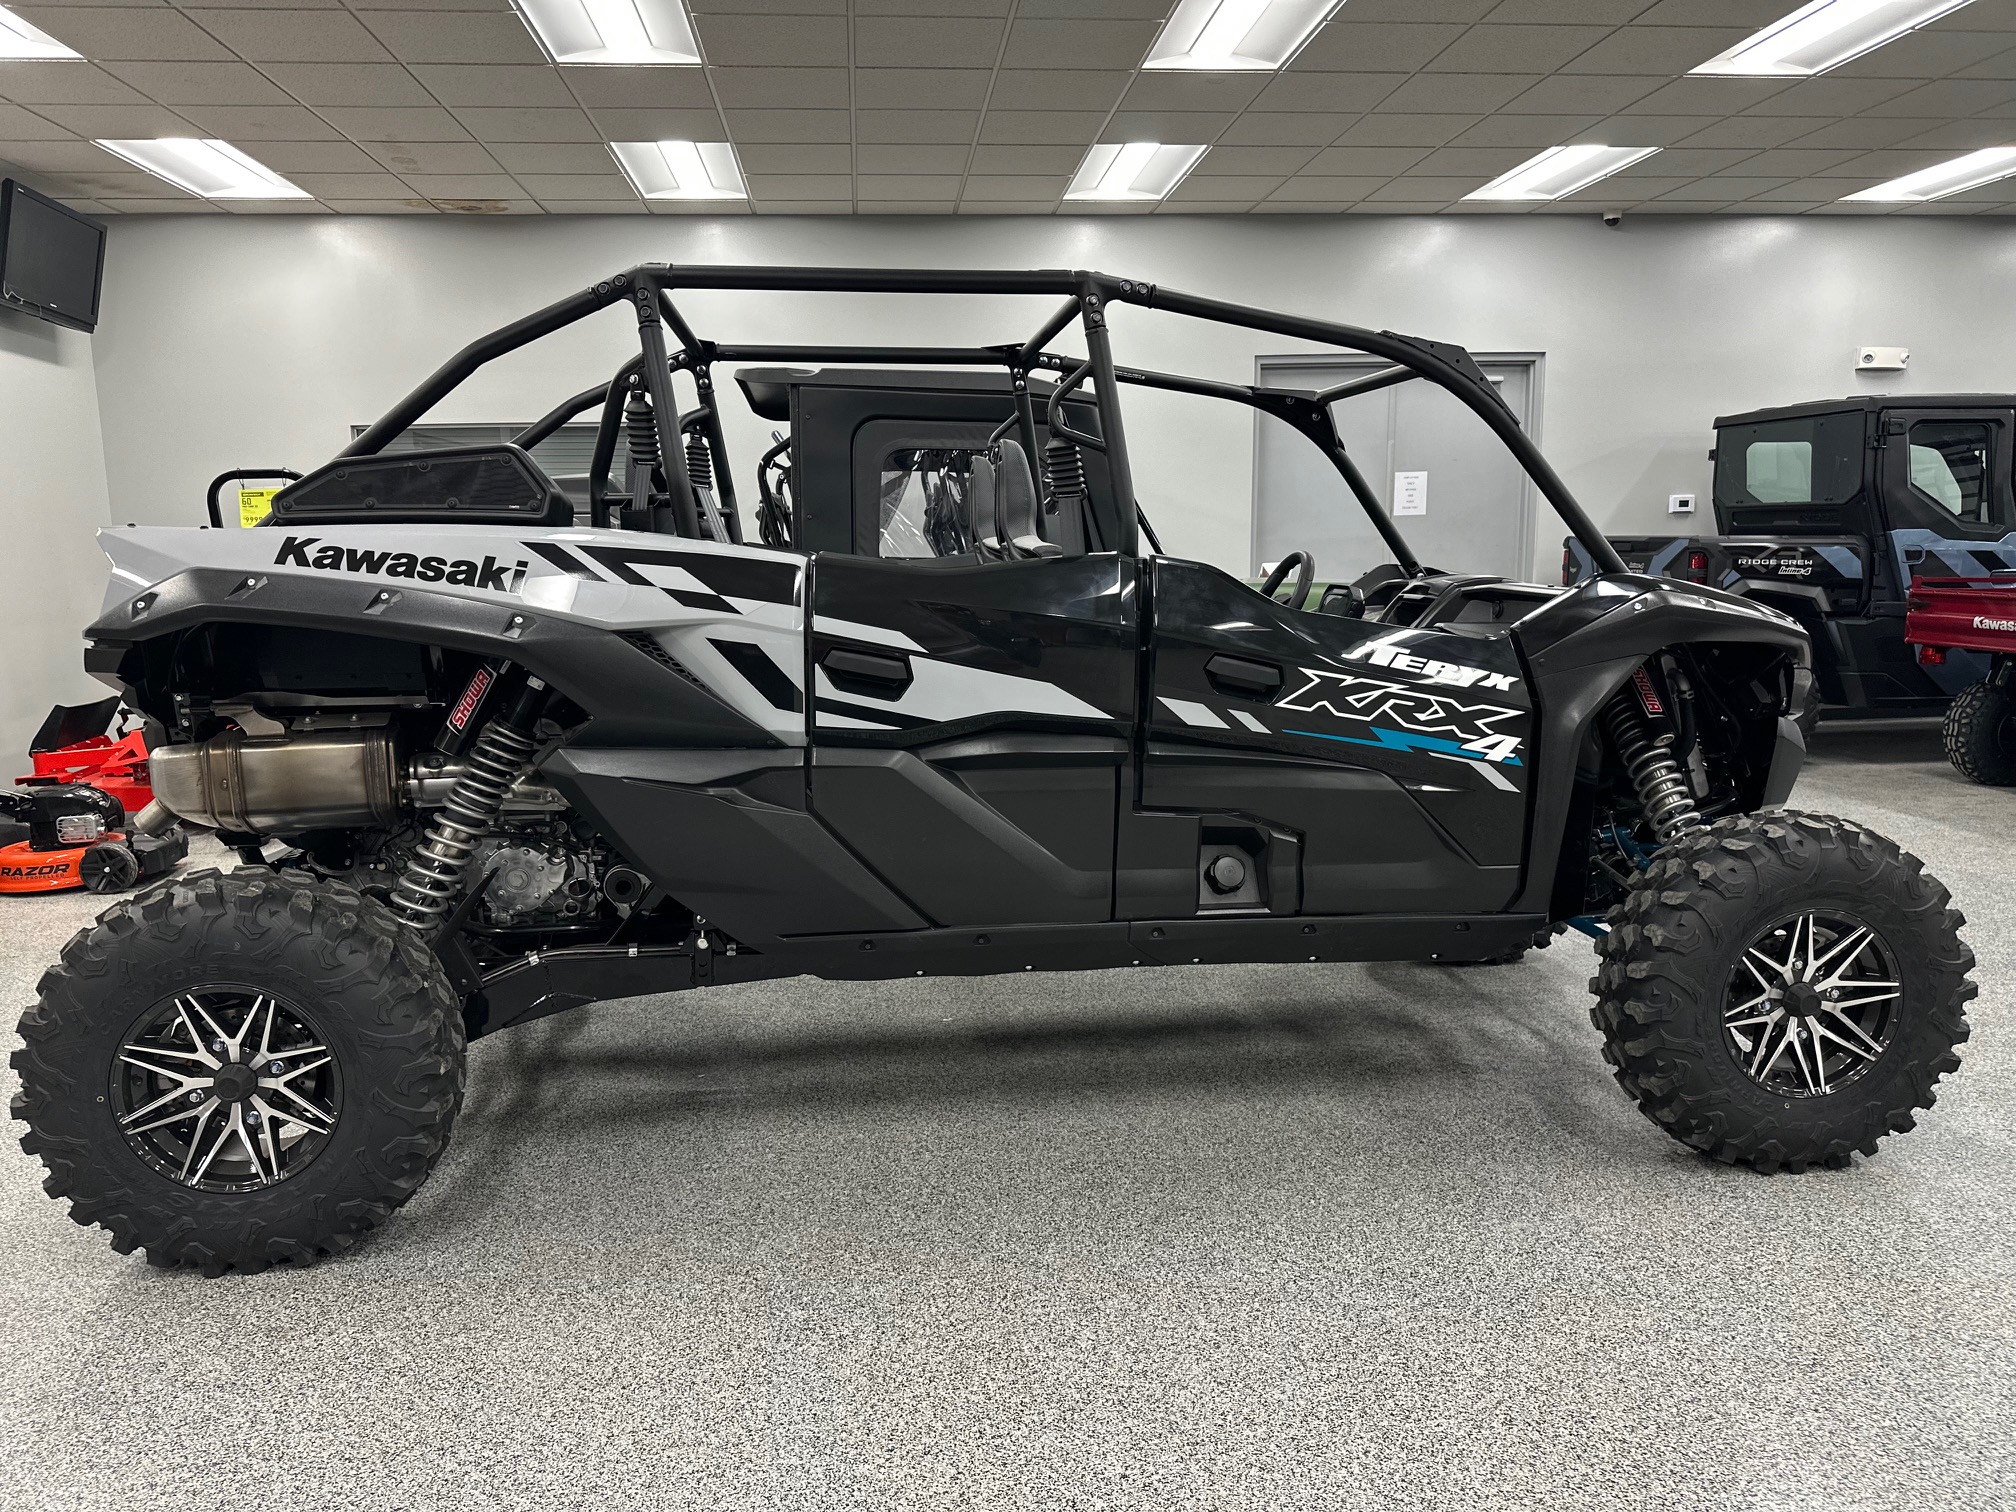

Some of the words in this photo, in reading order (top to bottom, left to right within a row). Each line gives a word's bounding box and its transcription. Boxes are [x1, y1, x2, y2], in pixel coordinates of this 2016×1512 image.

[274, 536, 529, 596] Kawasaki
[1973, 615, 2016, 632] Kawas
[452, 668, 491, 730] SHOWA
[1, 863, 70, 877] RAZOR
